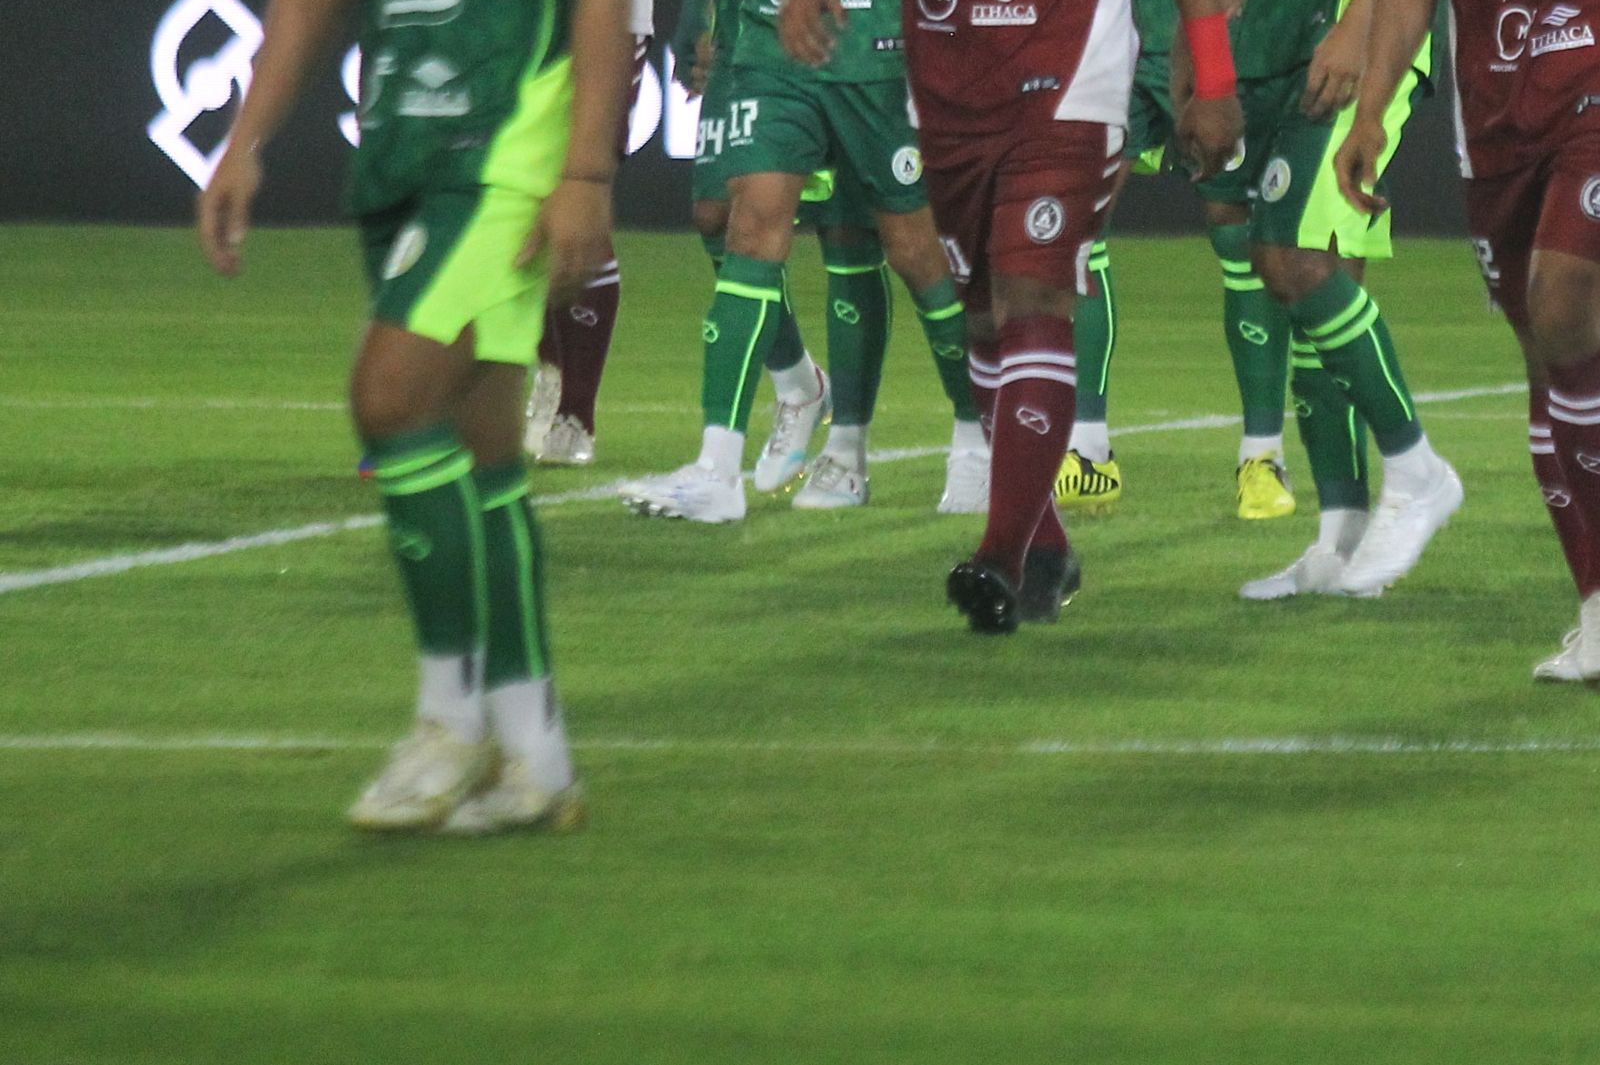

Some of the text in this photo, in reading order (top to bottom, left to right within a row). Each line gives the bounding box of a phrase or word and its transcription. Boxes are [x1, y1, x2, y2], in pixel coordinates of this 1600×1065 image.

[972, 4, 1036, 19] ITHACA
[1531, 24, 1593, 50] ITHACA
[728, 98, 760, 141] 17
